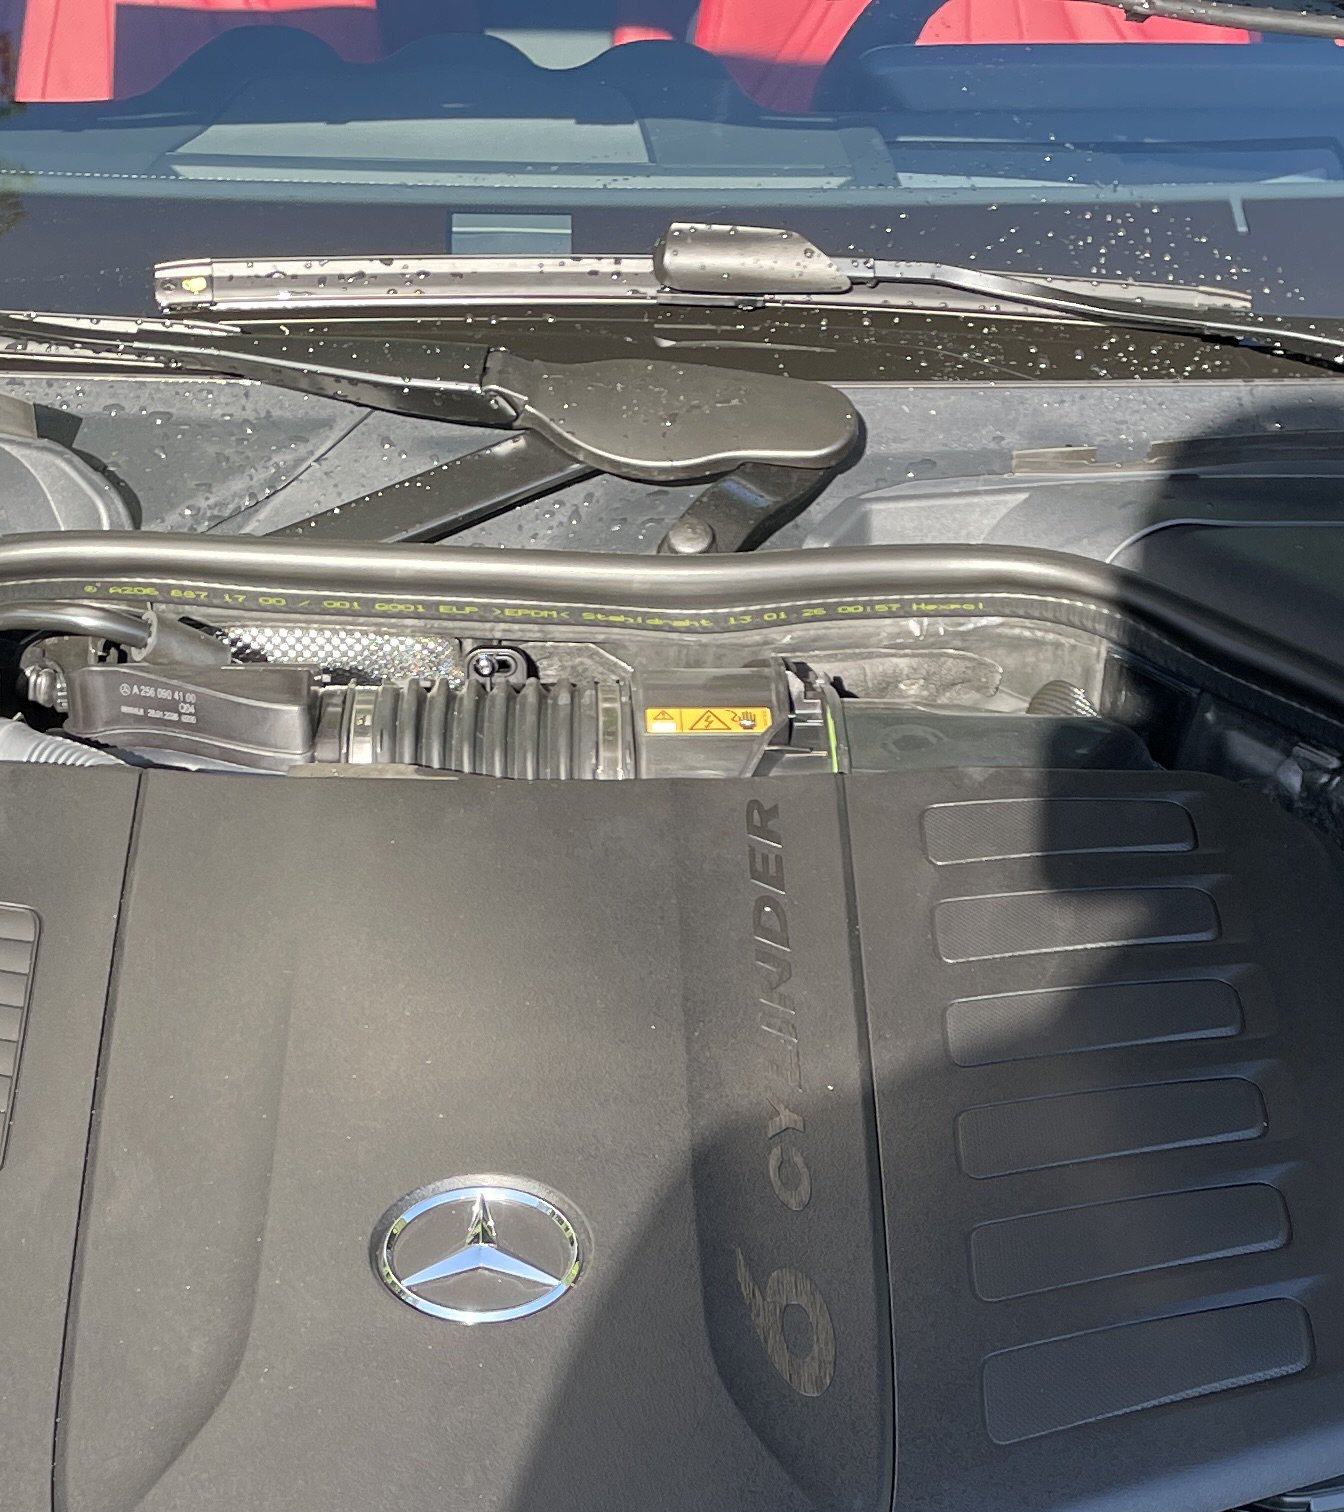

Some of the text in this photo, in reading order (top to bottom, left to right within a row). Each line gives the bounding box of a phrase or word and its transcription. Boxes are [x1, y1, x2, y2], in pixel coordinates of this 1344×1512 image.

[223, 593, 247, 604] 17
[258, 596, 287, 606] 00
[323, 600, 361, 610] 001
[438, 604, 479, 614] ELP
[490, 607, 570, 620] >EPDM<
[132, 684, 140, 695] A
[140, 685, 156, 698] 256
[173, 690, 184, 701] 41
[185, 692, 197, 704] 00
[736, 797, 837, 1397] 6 CYLINDER
